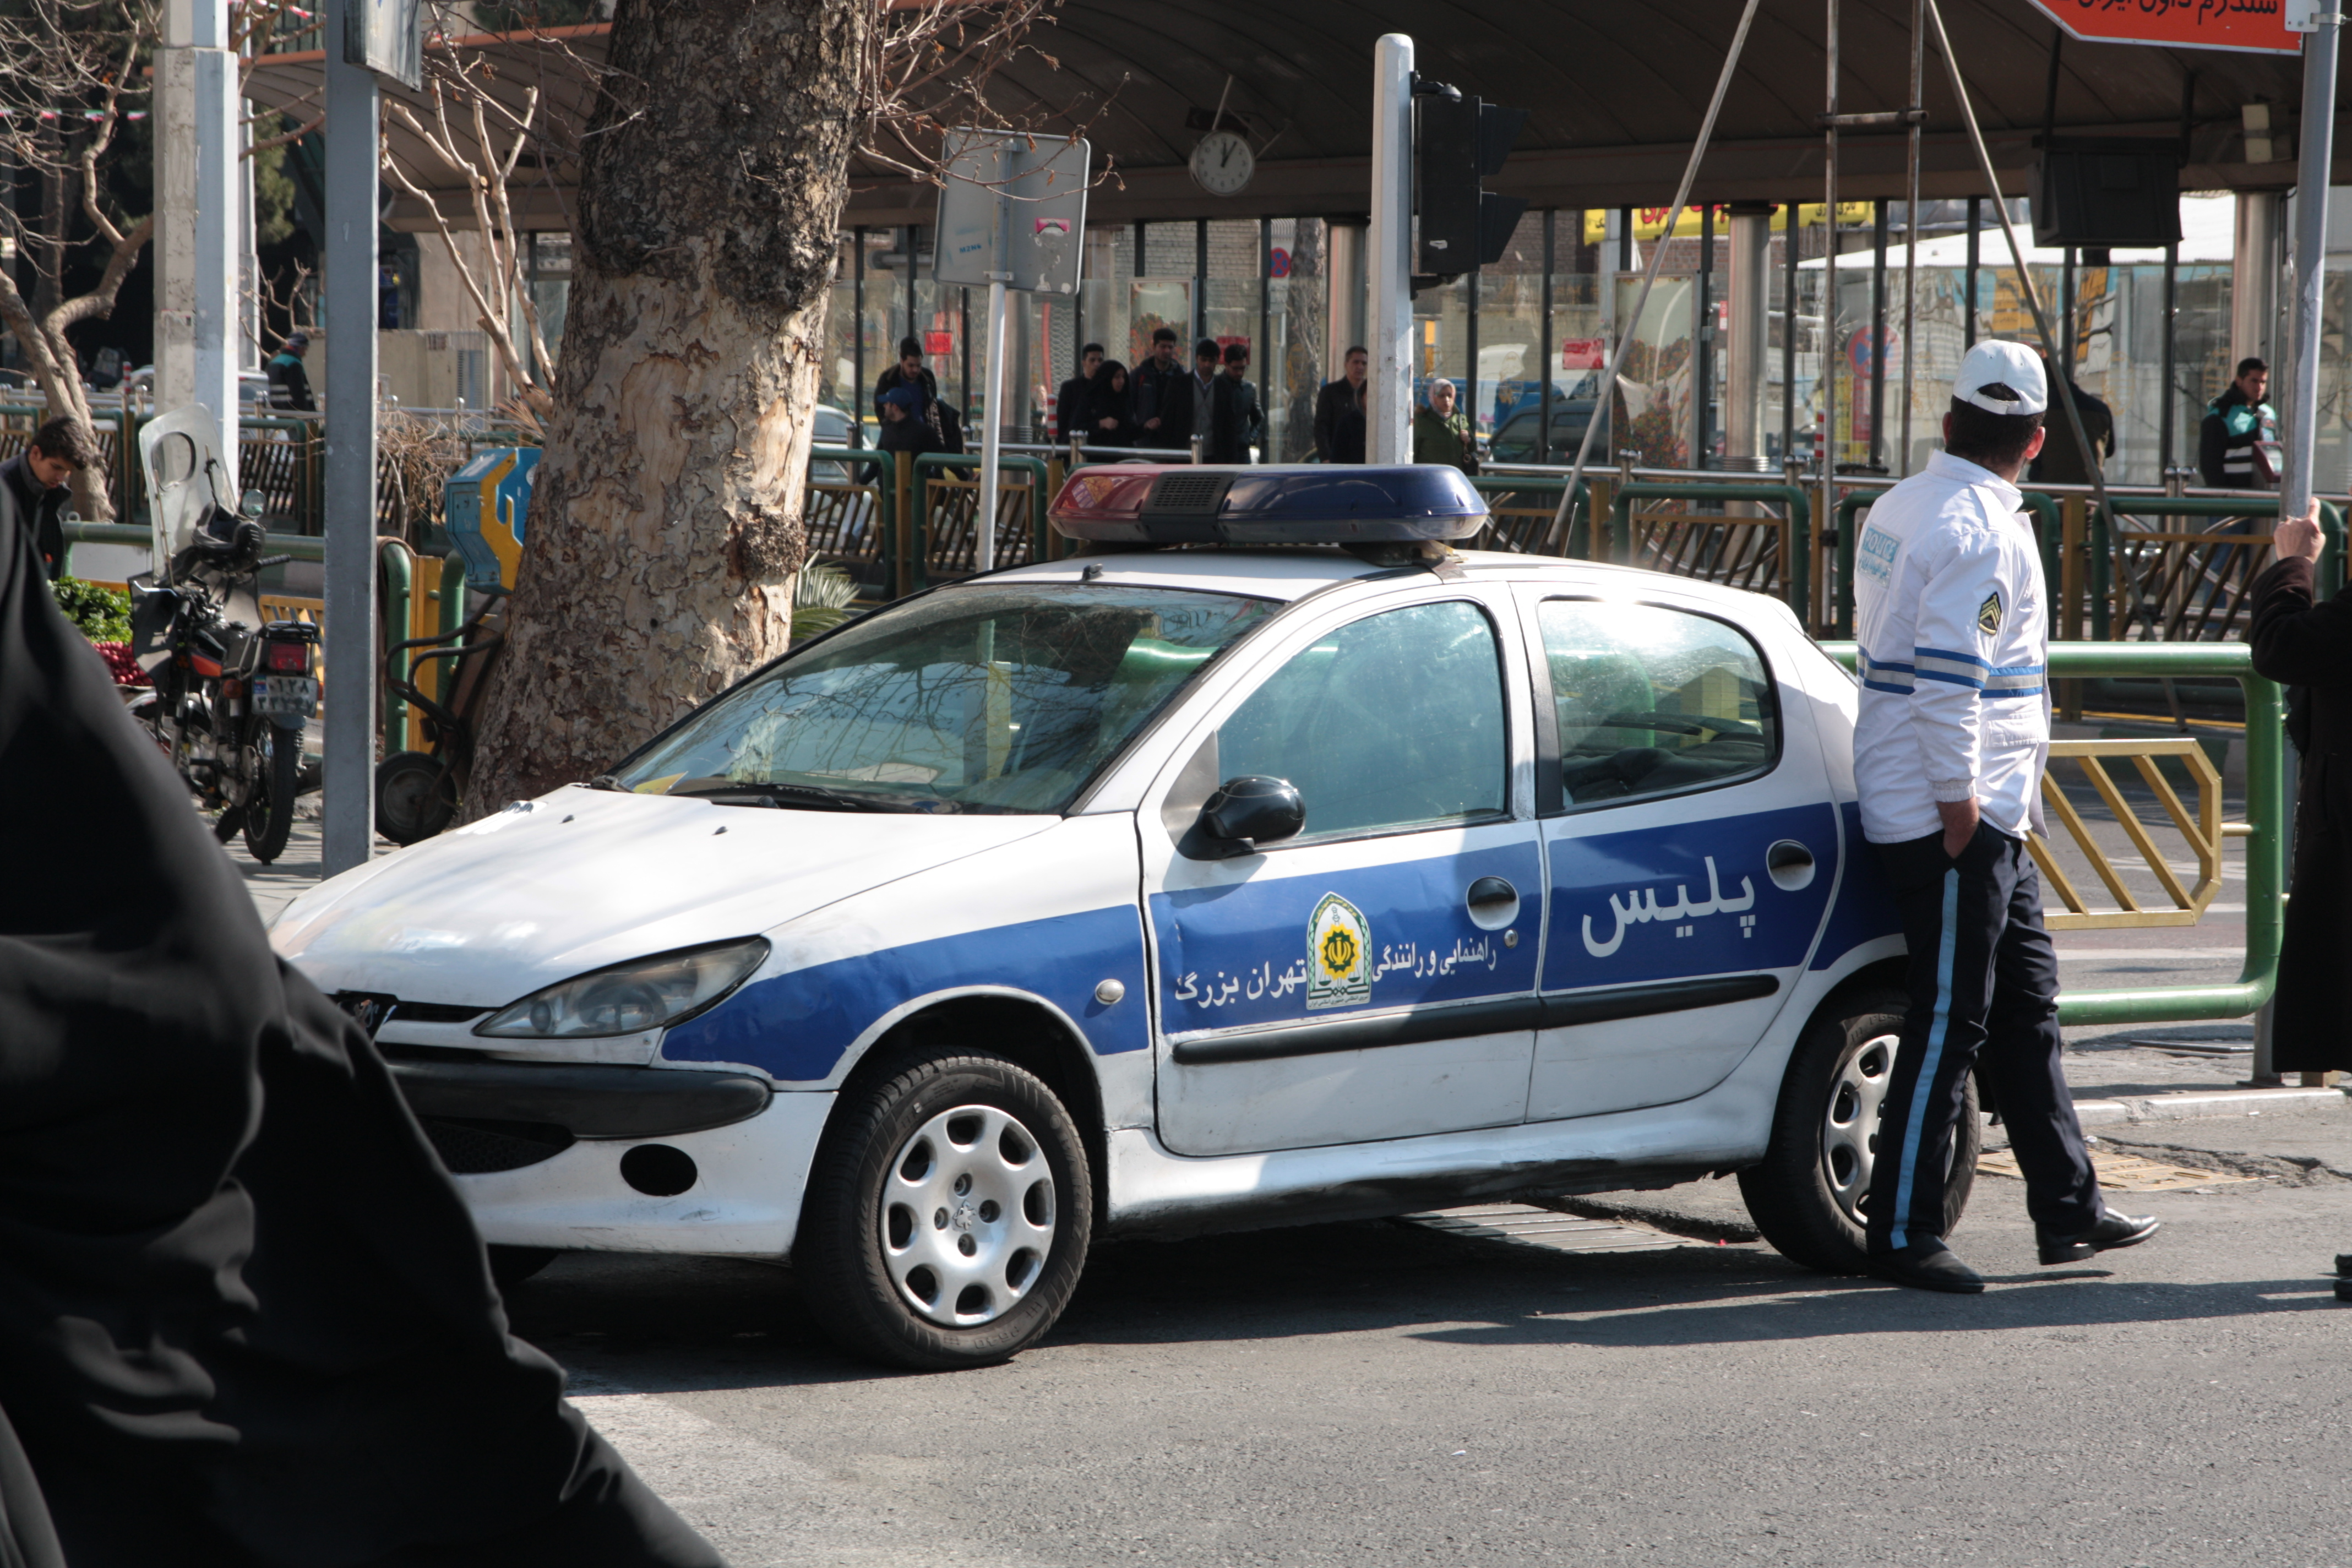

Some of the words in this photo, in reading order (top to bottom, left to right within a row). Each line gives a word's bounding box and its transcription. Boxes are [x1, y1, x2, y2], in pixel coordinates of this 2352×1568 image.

[1582, 856, 1755, 957] پلیس
[1371, 942, 1424, 982] رانندگی
[1428, 950, 1437, 975] و
[1439, 937, 1496, 975] راهنمایی
[1174, 972, 1239, 1008] بزرگ
[1246, 959, 1307, 999] تهران
[1057, 1131, 1085, 1241] BAREZ
